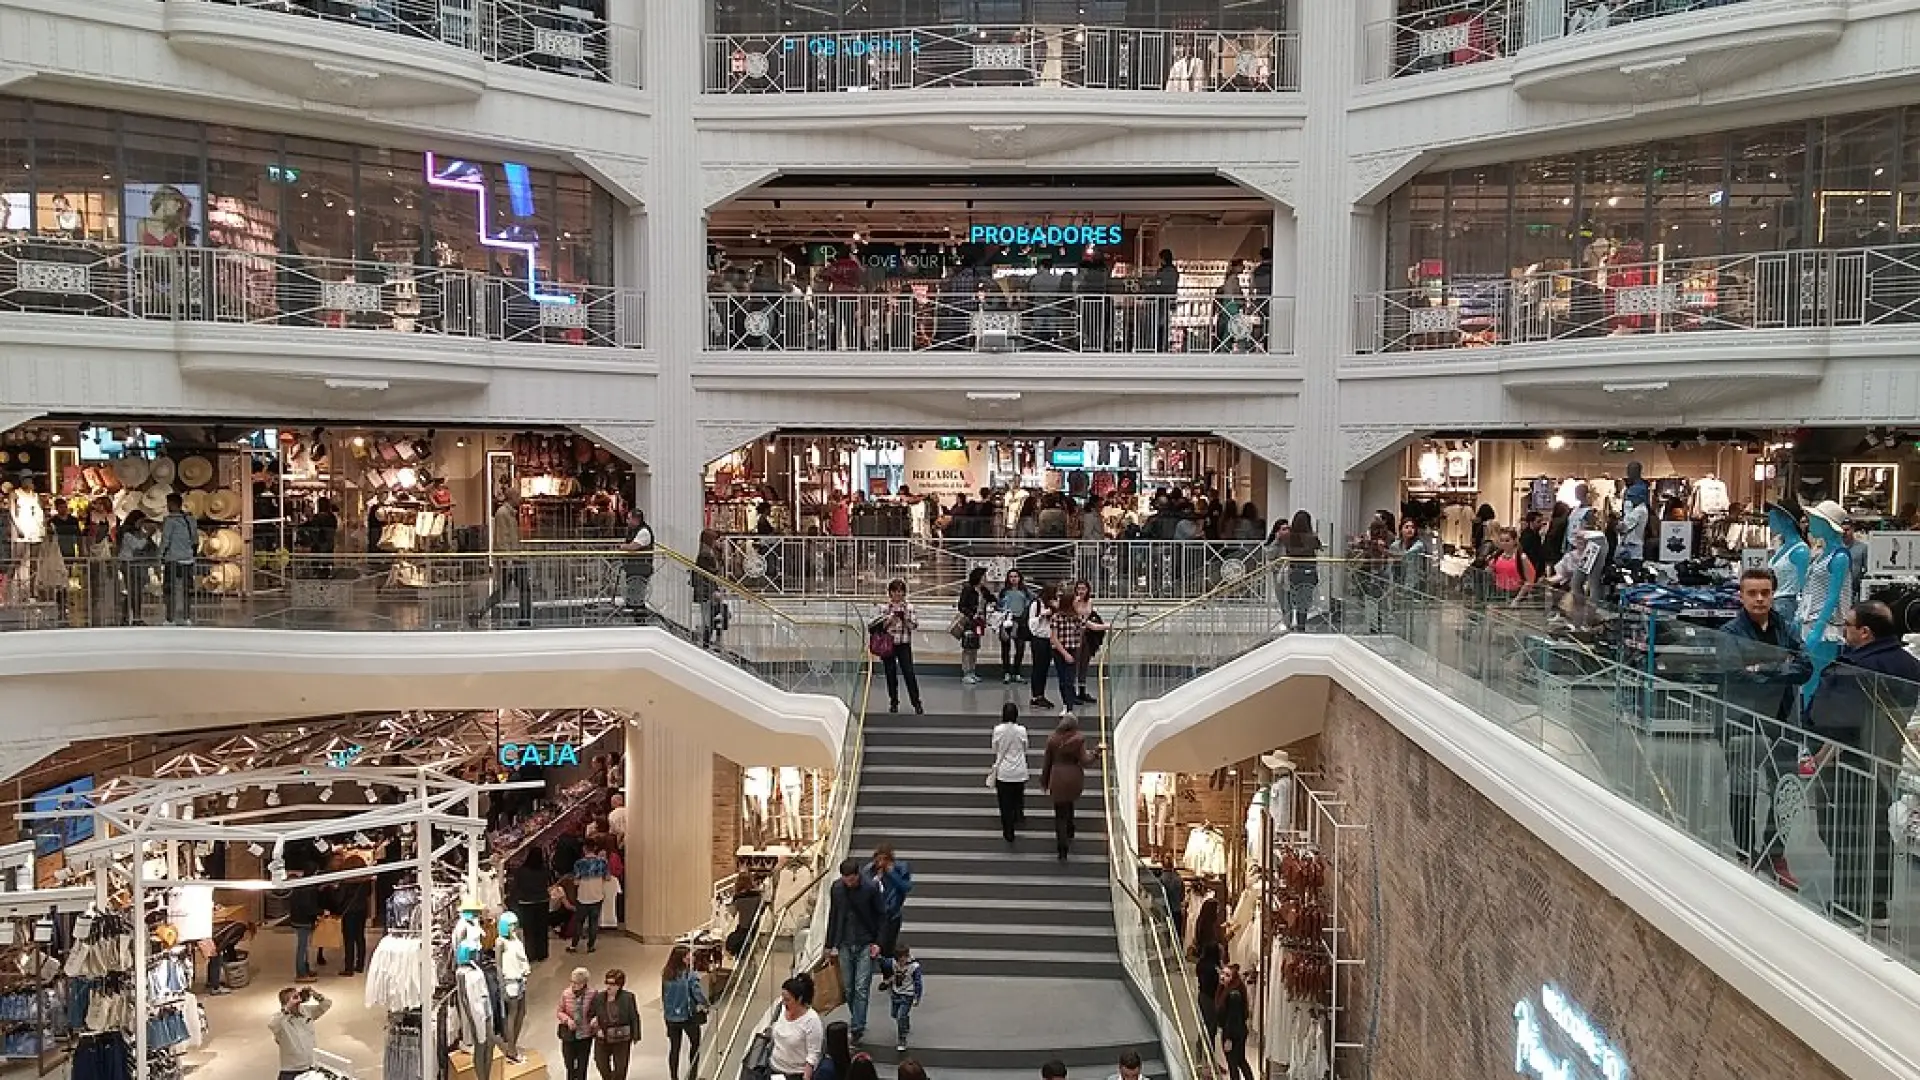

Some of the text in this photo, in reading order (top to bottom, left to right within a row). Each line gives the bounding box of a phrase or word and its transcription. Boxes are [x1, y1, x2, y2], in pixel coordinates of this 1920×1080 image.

[970, 224, 1122, 245] PROBADORES
[862, 254, 897, 267] LOVE
[901, 254, 939, 267] YOUR
[912, 470, 965, 480] RECARGA
[499, 743, 578, 766] CAJA
